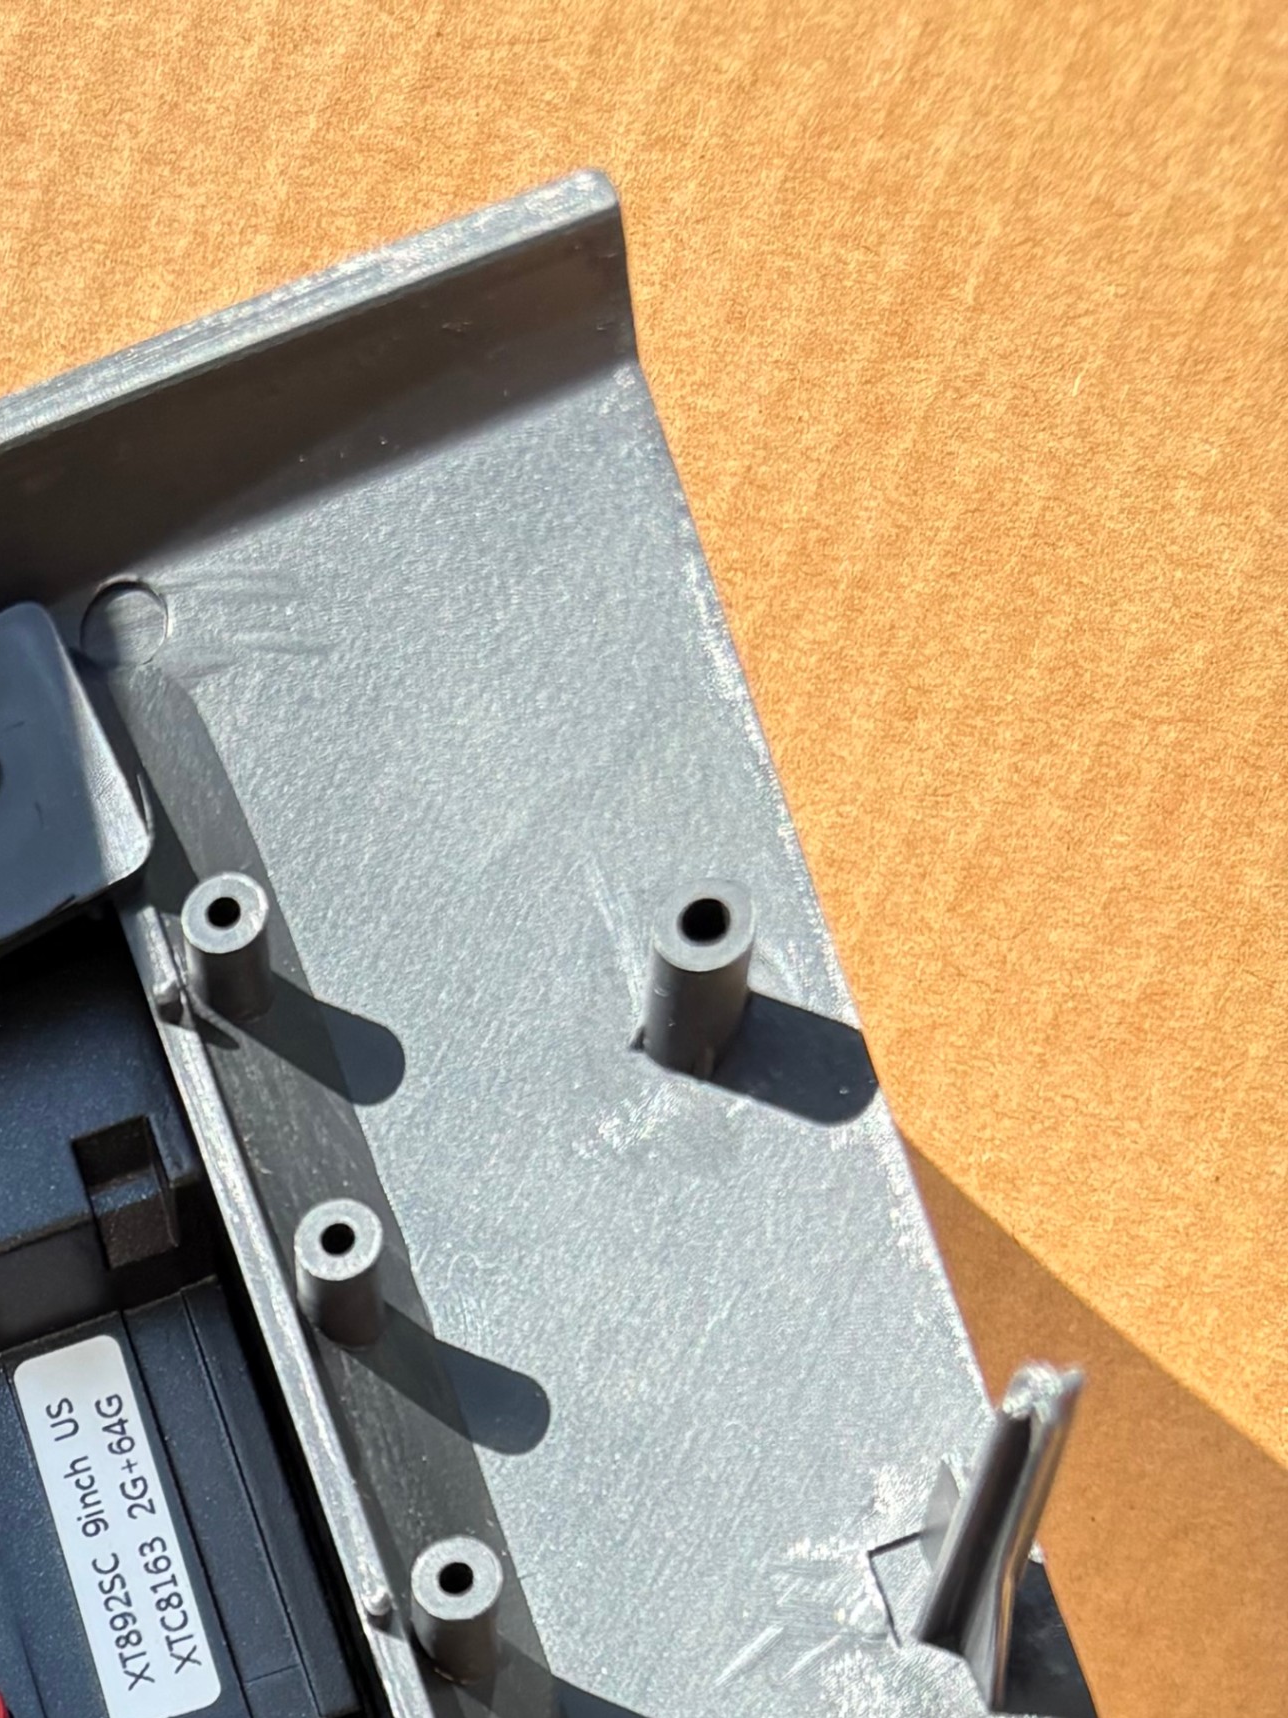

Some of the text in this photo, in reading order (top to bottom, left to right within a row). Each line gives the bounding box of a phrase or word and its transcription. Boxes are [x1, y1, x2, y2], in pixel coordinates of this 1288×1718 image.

[45, 1397, 155, 1691] XT892SC 9inch US
[94, 1393, 202, 1674] XTC8163 2G+64G
